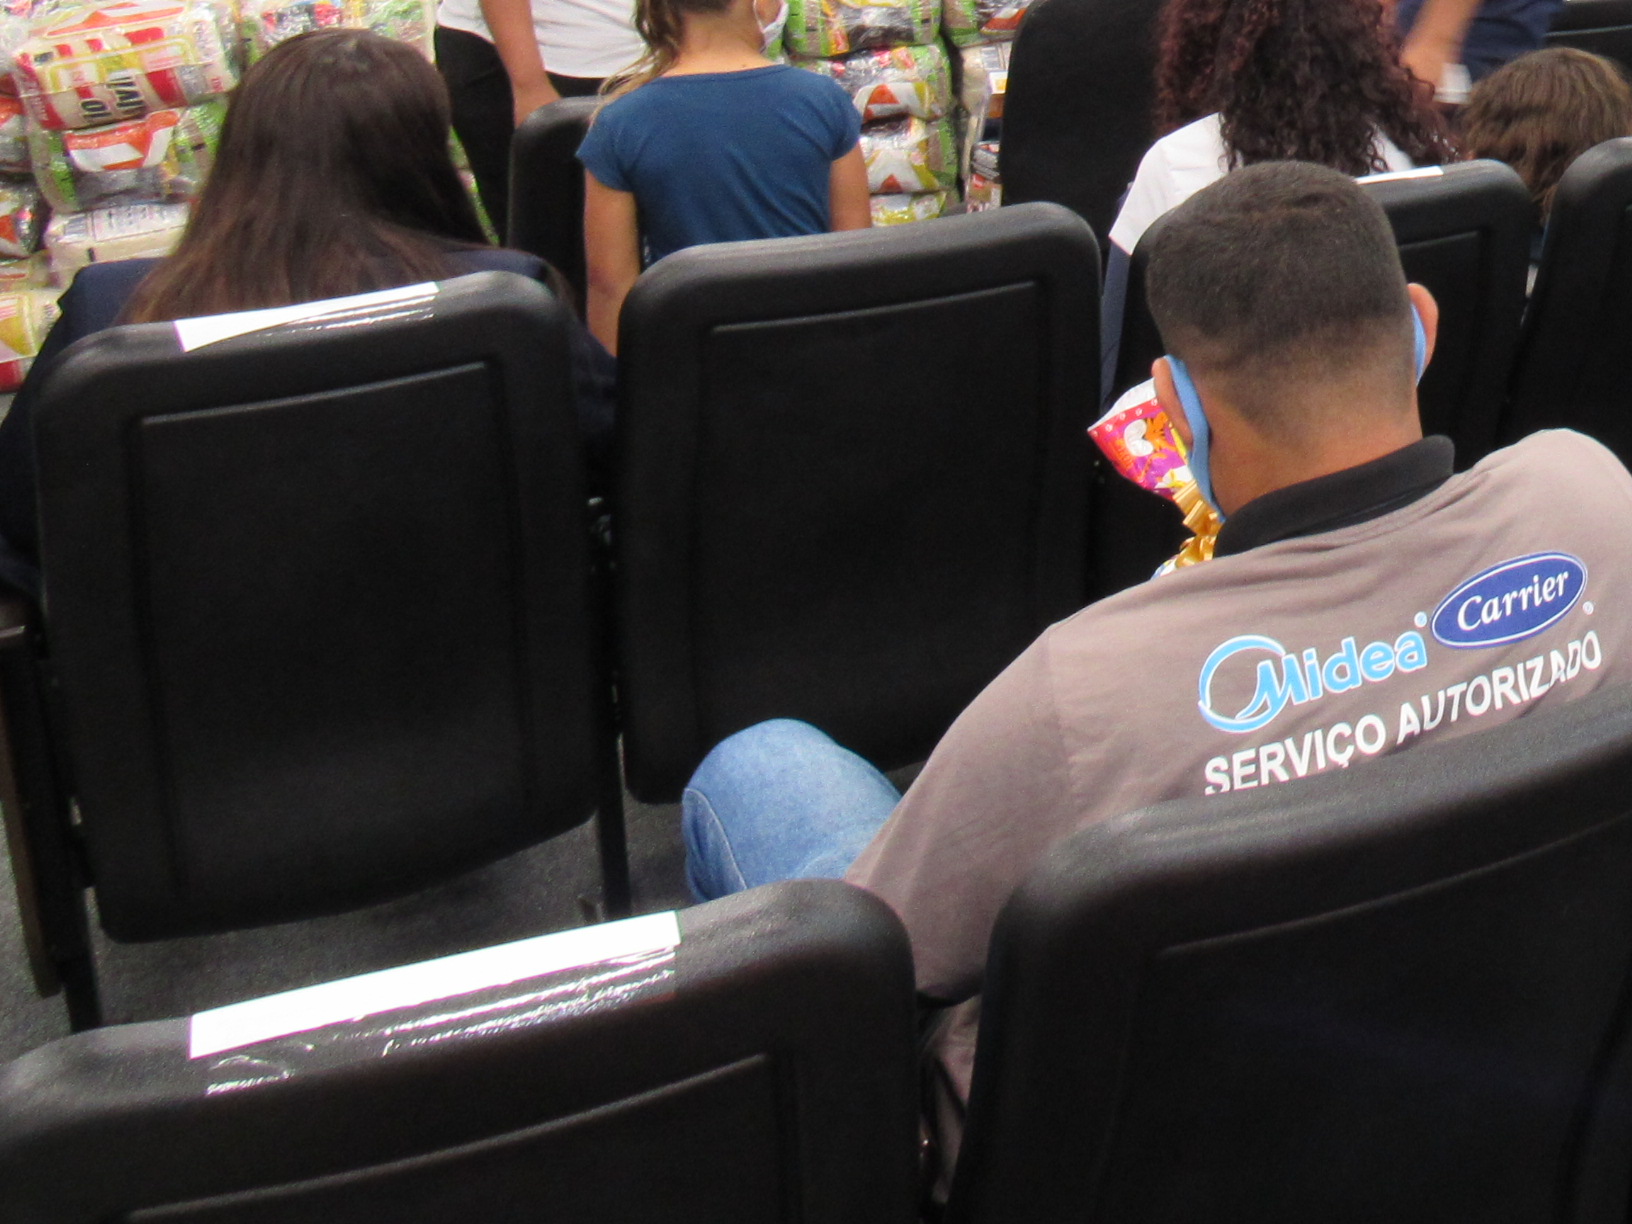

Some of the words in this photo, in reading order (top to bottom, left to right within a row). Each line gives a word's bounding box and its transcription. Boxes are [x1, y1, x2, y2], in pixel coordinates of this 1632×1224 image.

[1204, 714, 1387, 796] SERVIÇO
[1396, 630, 1602, 745] AUTORIZADO
[1210, 631, 1428, 728] Midea
[1456, 567, 1570, 632] Carrier
